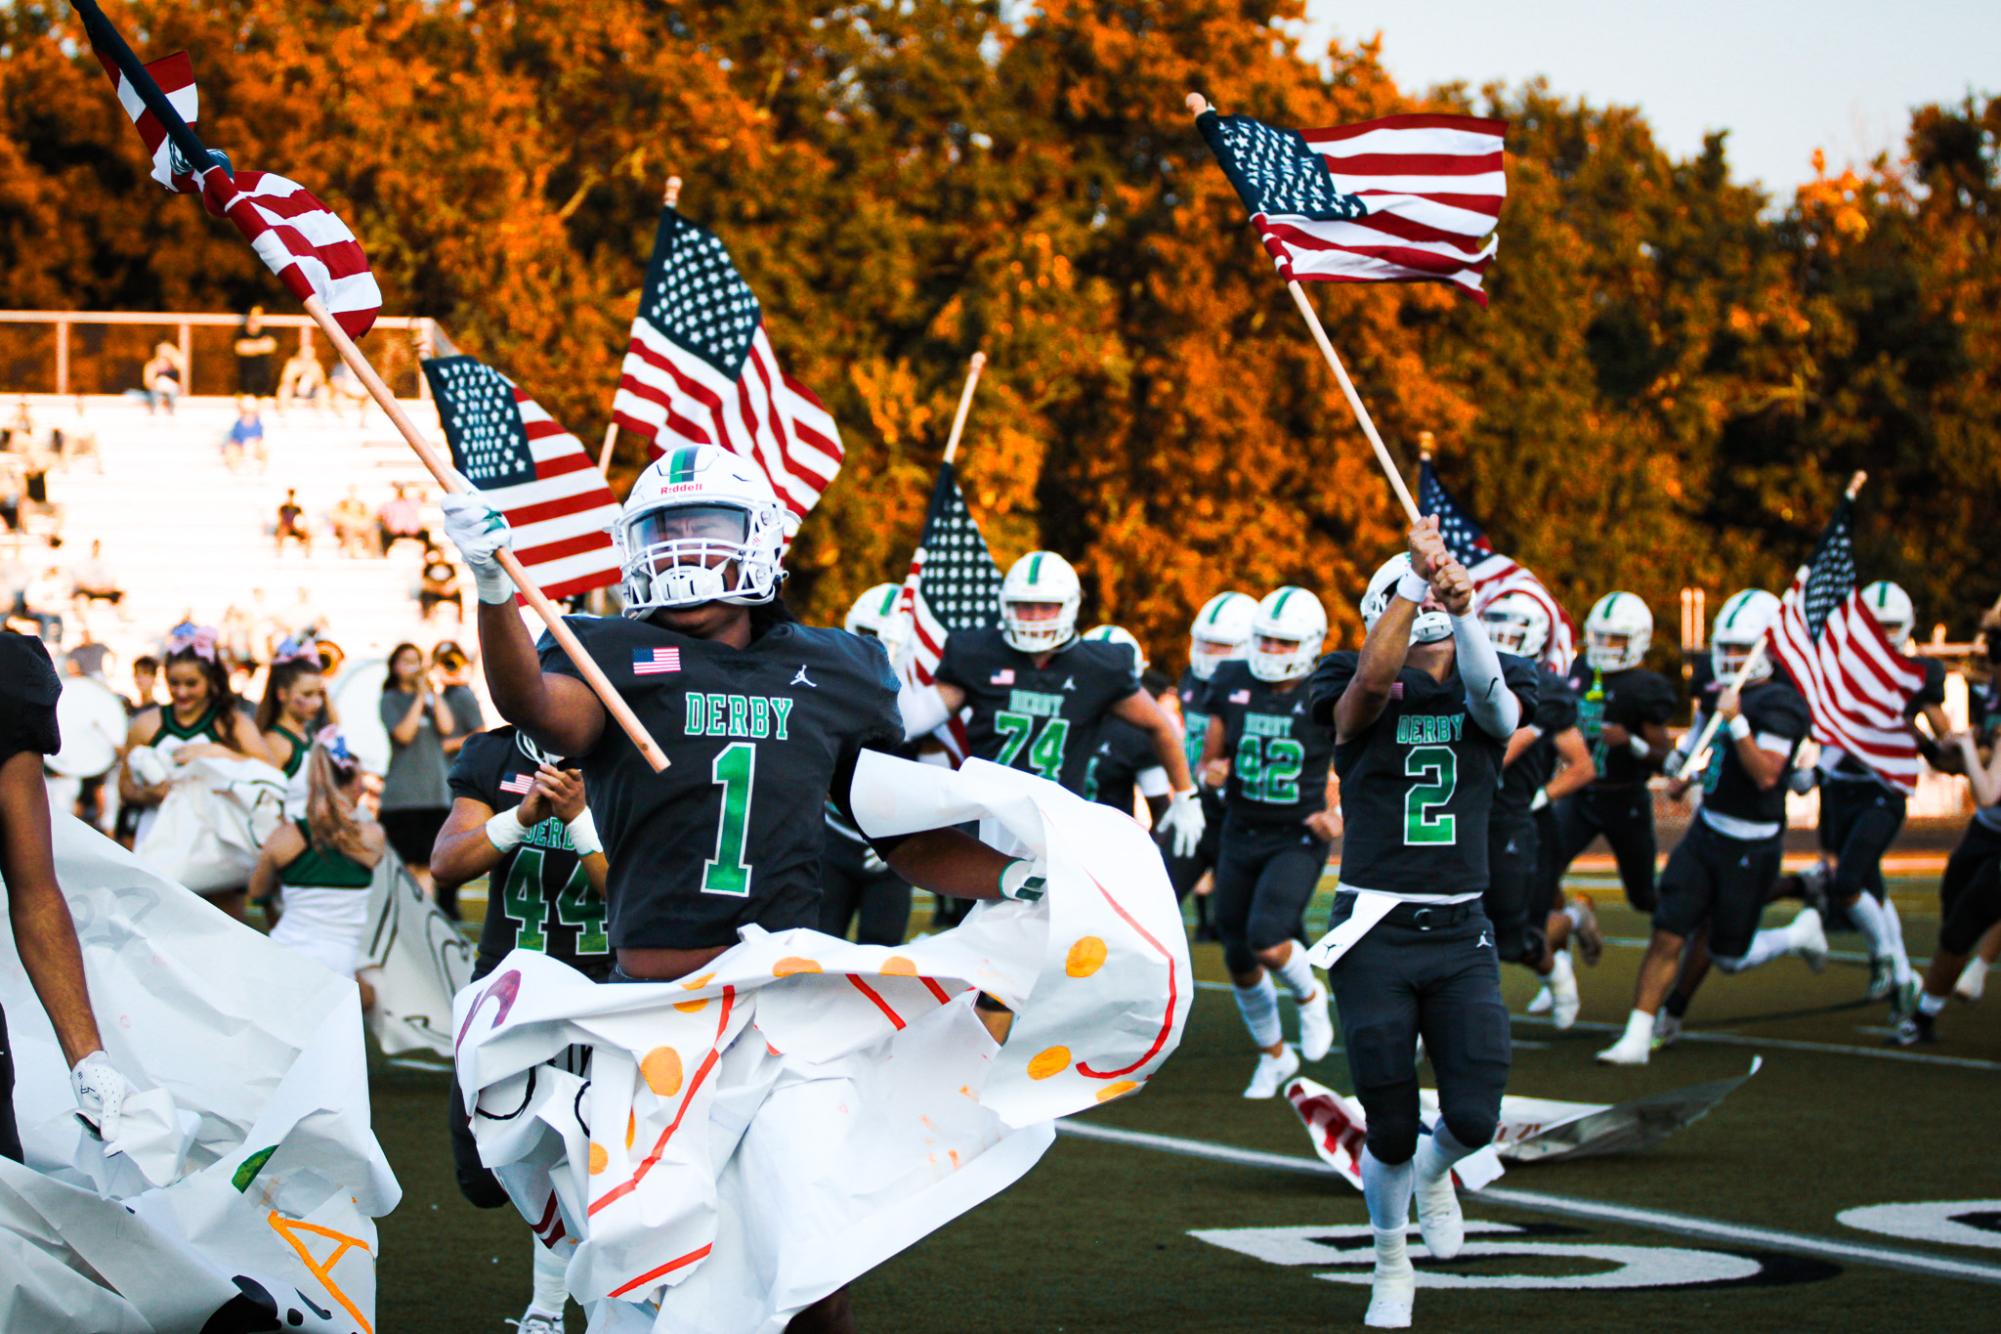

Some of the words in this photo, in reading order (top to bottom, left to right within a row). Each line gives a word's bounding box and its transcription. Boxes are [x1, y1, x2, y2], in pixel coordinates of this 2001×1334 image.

[684, 692, 793, 740] DERBY
[994, 710, 1070, 783] 74
[1397, 713, 1465, 744] DERBY
[1235, 734, 1304, 804] 42
[1404, 745, 1457, 846] 2
[701, 742, 756, 897] 1
[503, 846, 609, 955] 44
